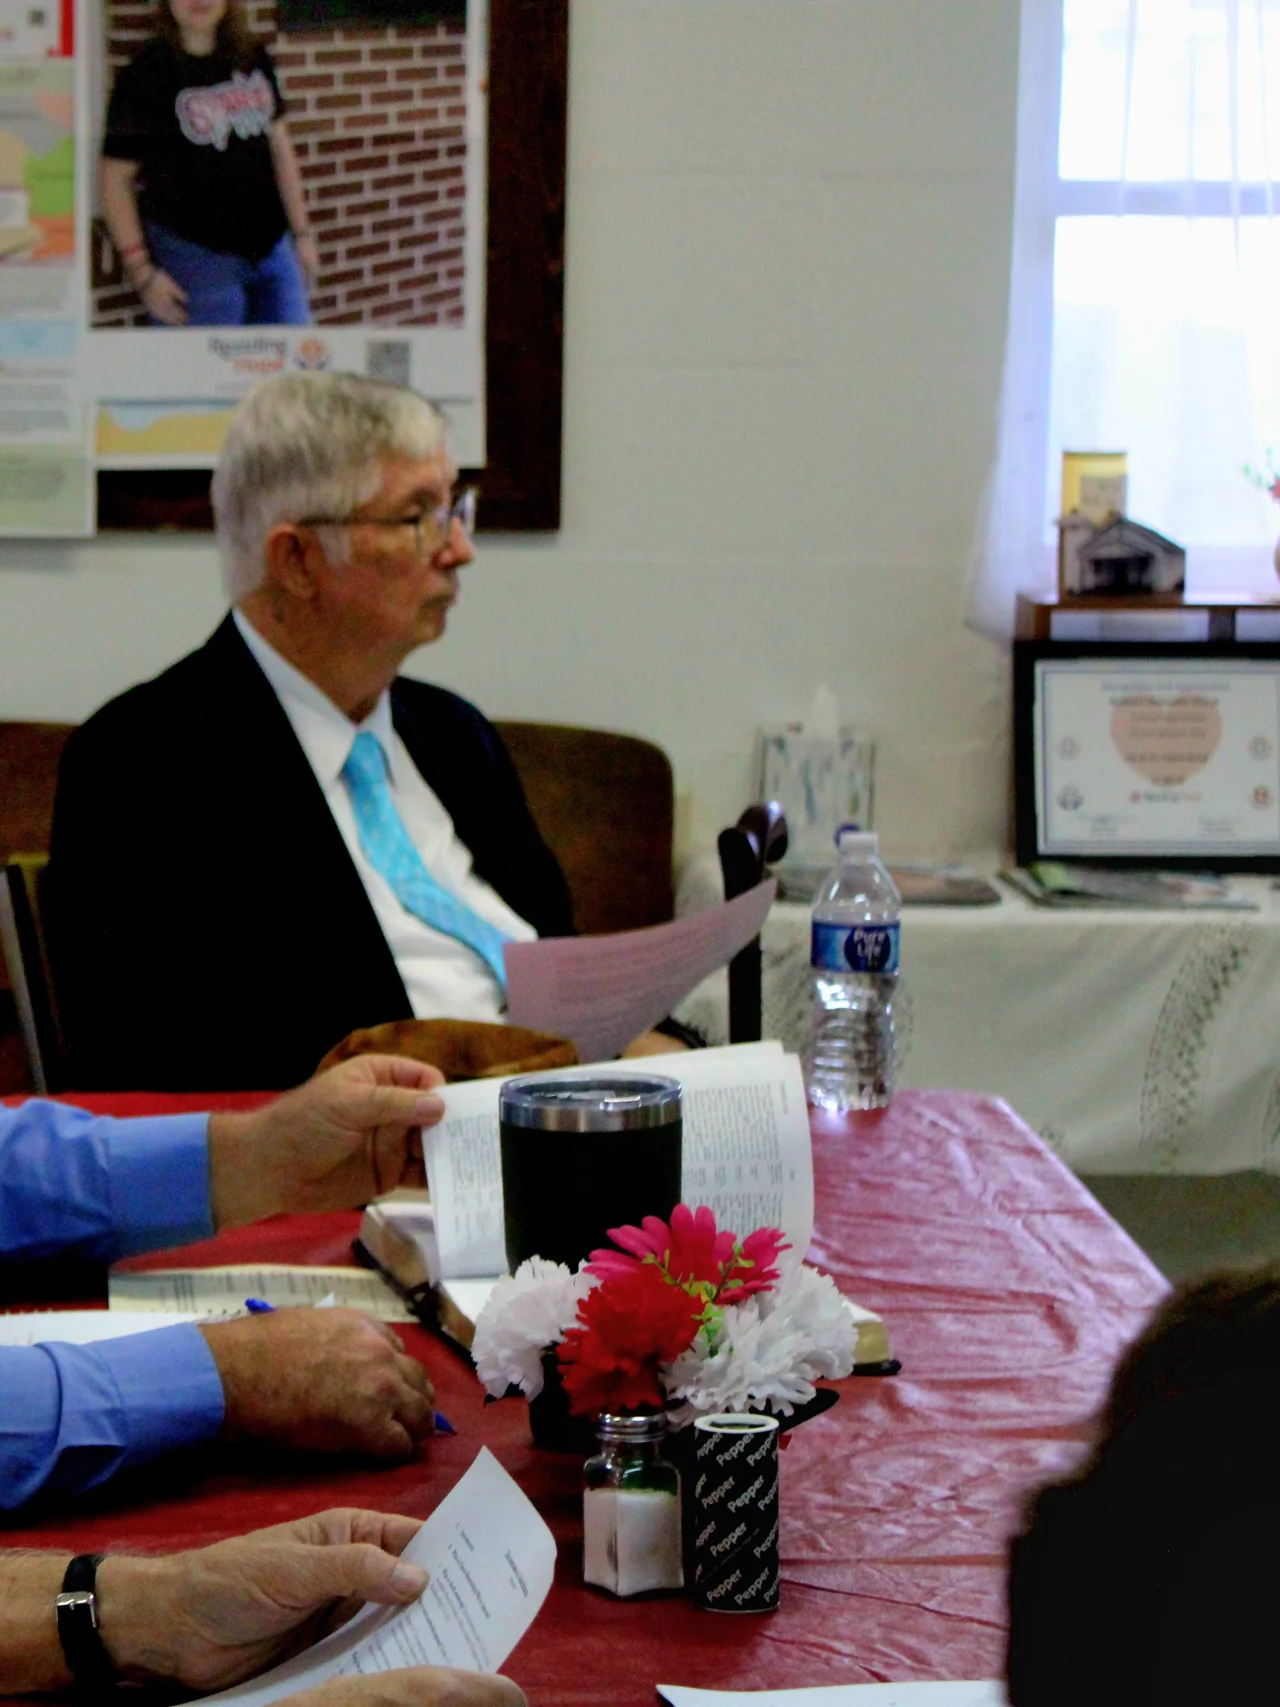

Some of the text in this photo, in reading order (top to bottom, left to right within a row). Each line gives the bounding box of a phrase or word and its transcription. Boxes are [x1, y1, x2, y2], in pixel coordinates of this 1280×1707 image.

[716, 1433, 755, 1466] Pepper
[702, 1476, 735, 1510] Pepper
[727, 1475, 764, 1513] Pepper
[710, 1522, 747, 1557] Pepper
[706, 1569, 742, 1602] Pepper
[734, 1566, 770, 1606] Pepper
